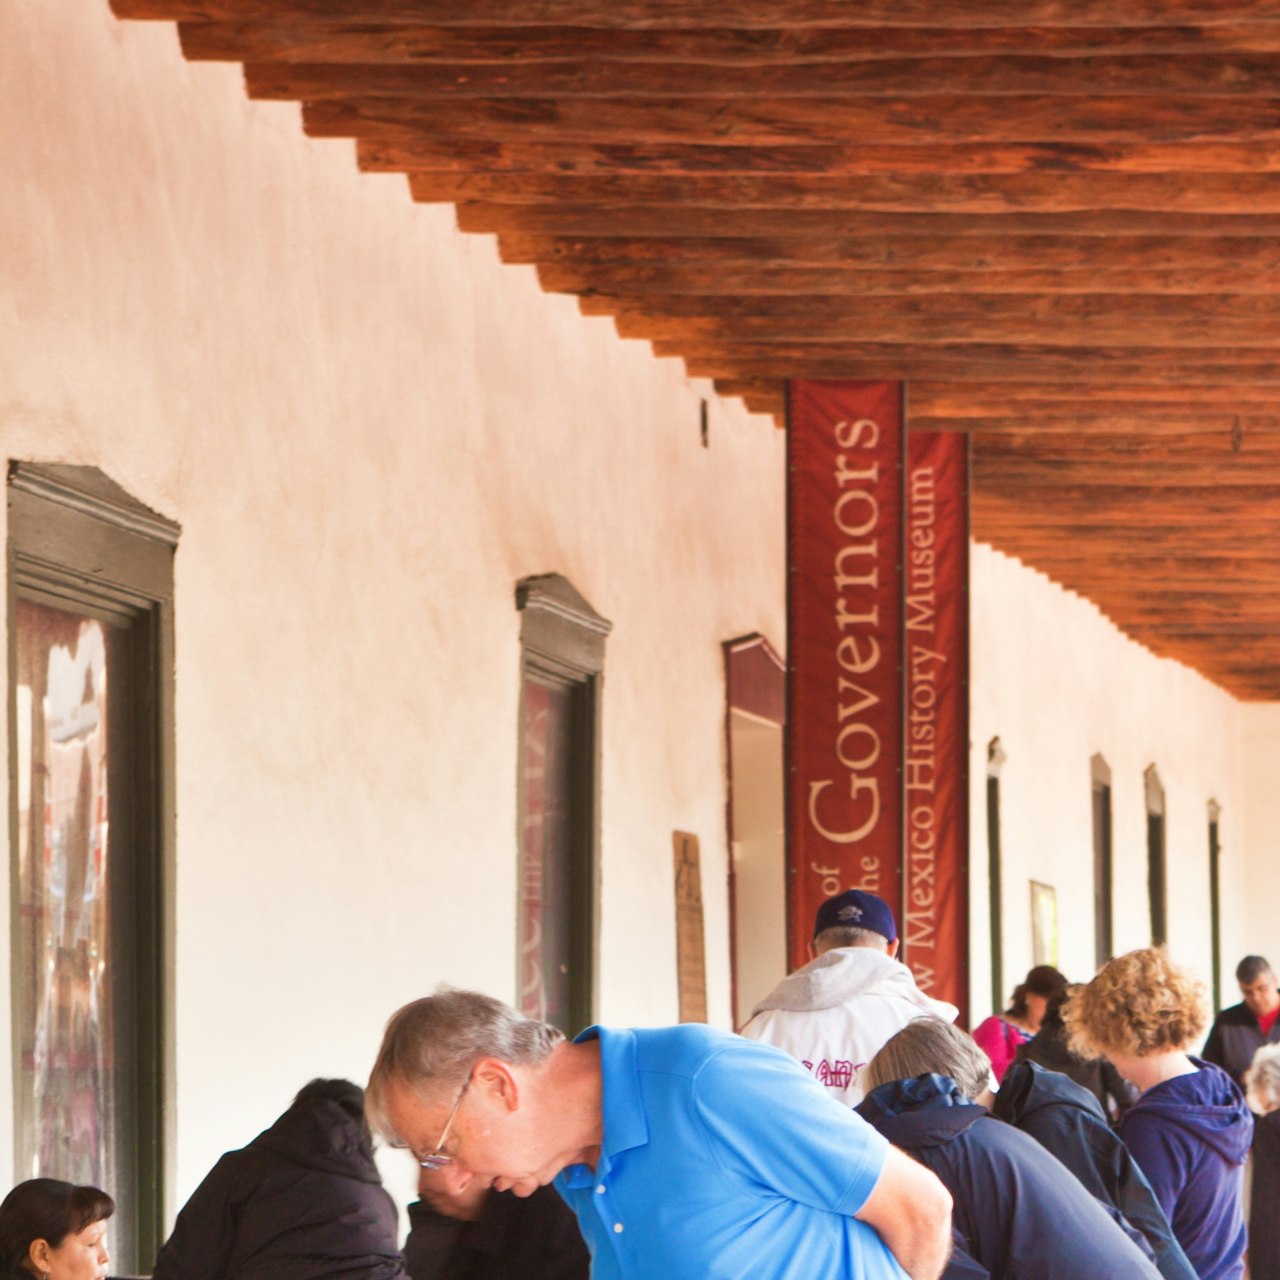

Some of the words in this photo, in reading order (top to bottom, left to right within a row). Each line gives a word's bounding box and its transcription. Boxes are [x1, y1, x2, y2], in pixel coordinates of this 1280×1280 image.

[904, 465, 936, 634] Museum
[808, 418, 881, 844] Governors
[905, 644, 948, 794] History
[811, 861, 840, 897] of
[849, 856, 880, 892] he
[905, 805, 936, 949] Mexico
